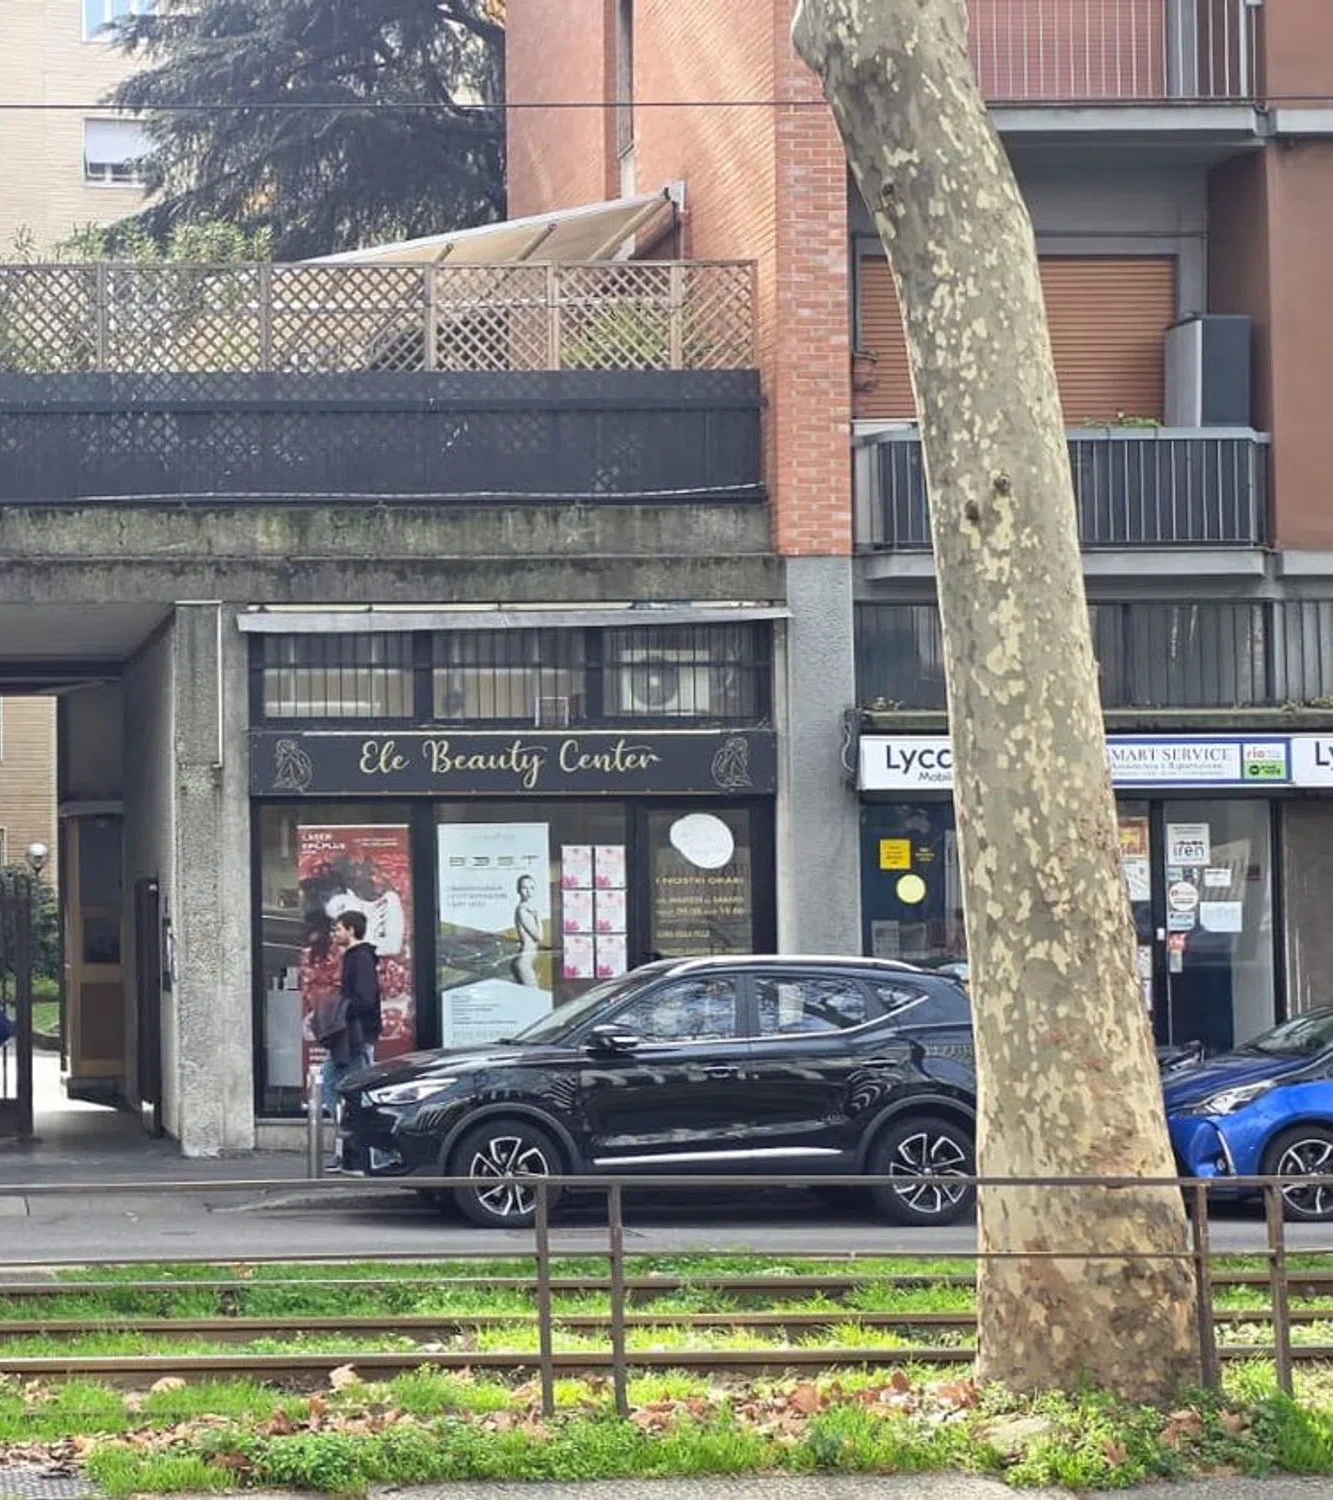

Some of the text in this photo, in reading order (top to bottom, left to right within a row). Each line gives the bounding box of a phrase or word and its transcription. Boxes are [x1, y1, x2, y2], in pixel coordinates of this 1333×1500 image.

[359, 738, 662, 789] Ele Beauty Center
[1109, 747, 1155, 761] MART
